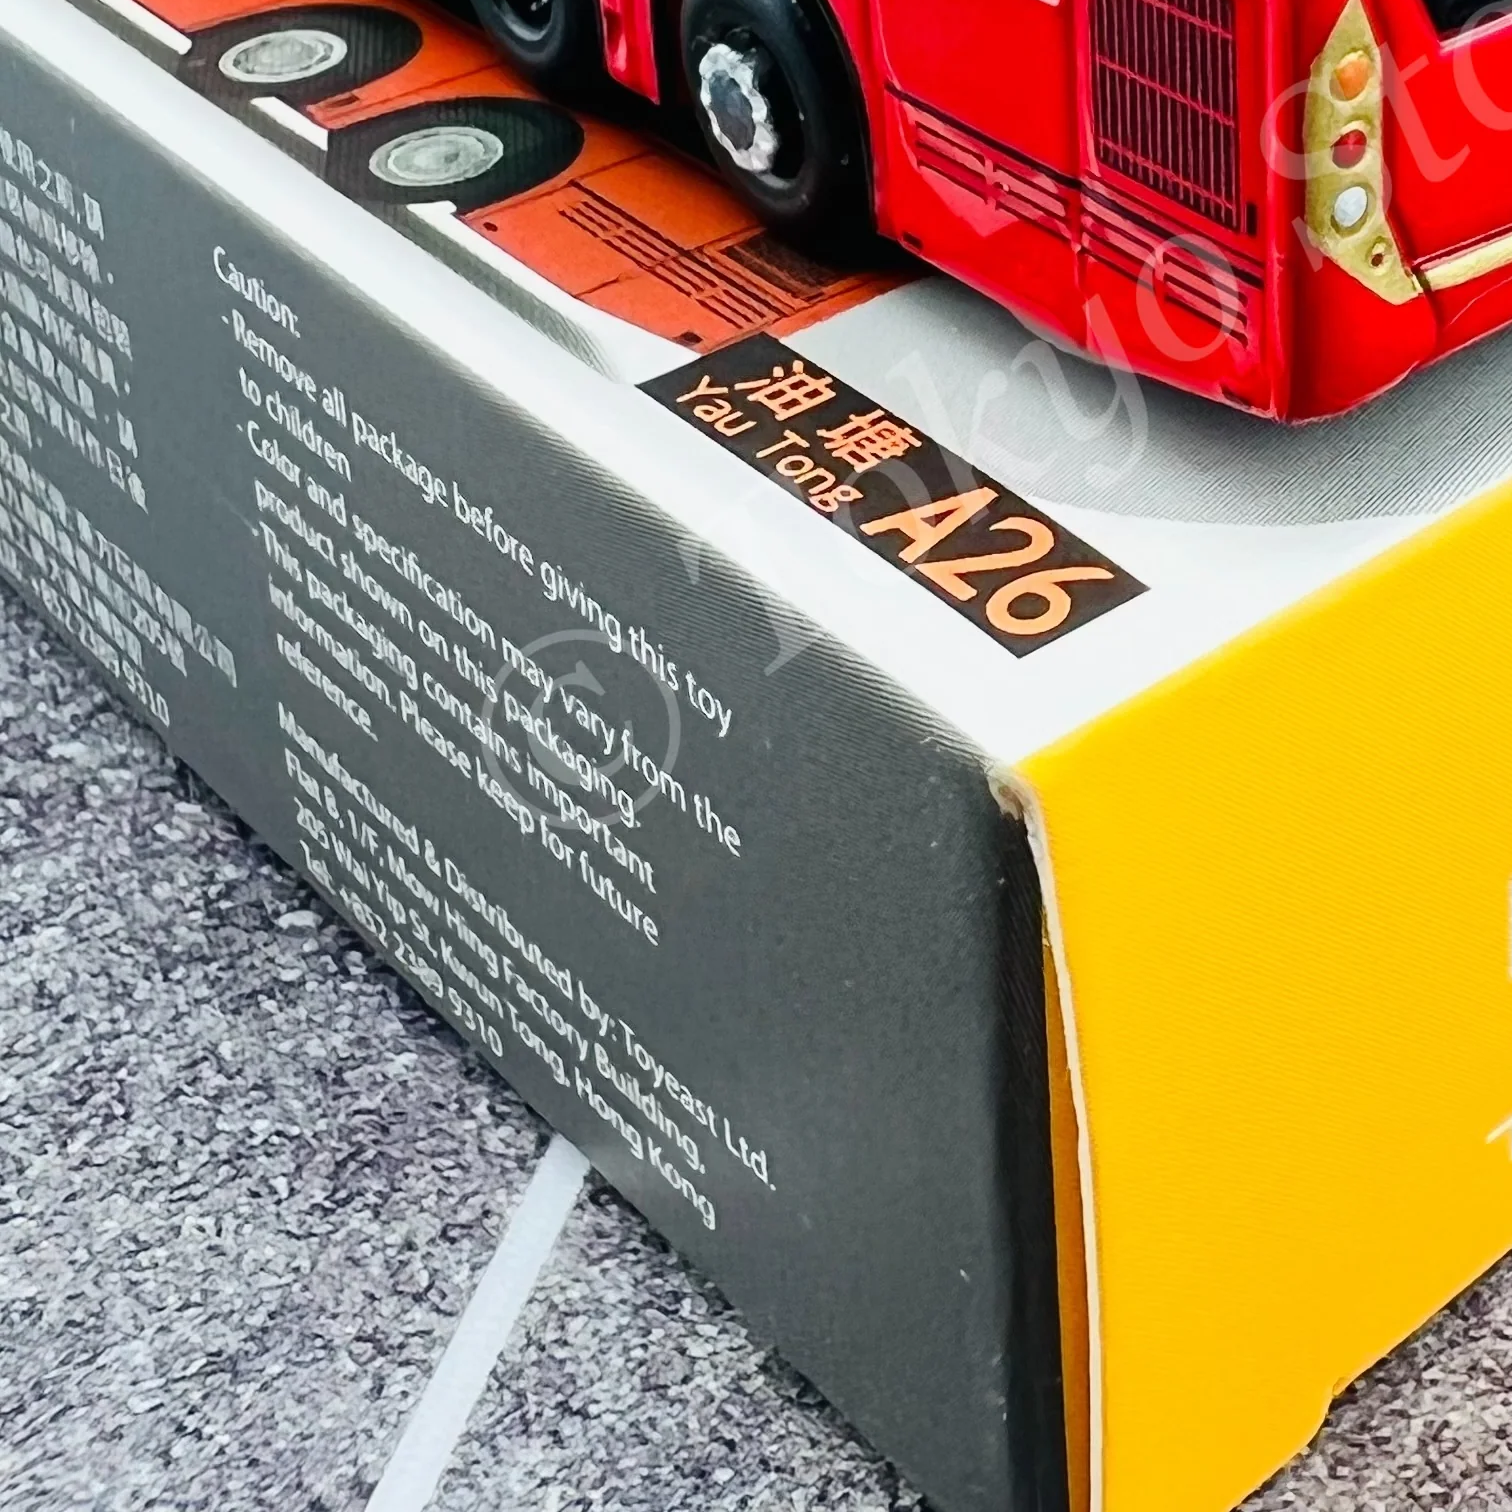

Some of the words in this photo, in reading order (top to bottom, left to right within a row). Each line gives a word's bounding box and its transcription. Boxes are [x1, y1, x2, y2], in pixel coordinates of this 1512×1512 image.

[213, 245, 301, 338] Caution:
[238, 366, 262, 407] to
[265, 390, 352, 483] children
[675, 374, 757, 437] Yau
[755, 430, 864, 513] Tong
[734, 359, 922, 474] 油塘
[232, 308, 317, 403] Remove
[321, 386, 347, 428] all
[351, 411, 449, 508] package
[453, 480, 535, 577] before
[540, 561, 622, 654] giving
[628, 626, 679, 691] this
[685, 669, 733, 738] toy
[859, 486, 1115, 635] A26
[247, 419, 301, 489] Color
[306, 475, 347, 527] and
[352, 514, 497, 651] specification
[501, 637, 553, 703] may
[560, 686, 615, 756] vary
[621, 728, 687, 813] from
[693, 793, 741, 858] the
[254, 478, 338, 568] product
[340, 549, 414, 633] shown
[418, 619, 450, 662] on
[453, 642, 498, 703] this
[503, 689, 641, 828] packaging.
[259, 520, 303, 583] This
[305, 568, 419, 691] packaging
[422, 671, 522, 774] contains
[526, 752, 657, 894] important
[400, 690, 471, 779] Please
[475, 756, 534, 835] keep
[540, 814, 575, 870] for
[579, 850, 659, 947] future
[278, 701, 420, 856] Manufactured
[444, 857, 573, 1001] Distributed
[577, 979, 618, 1041] by:
[618, 1018, 718, 1138] Toyeast
[723, 1116, 777, 1191] Ltd.
[444, 897, 499, 979] Hing
[502, 954, 588, 1062] Factory
[447, 986, 504, 1058] 9310
[574, 1066, 644, 1160] Hong
[648, 1136, 716, 1231] Kong
